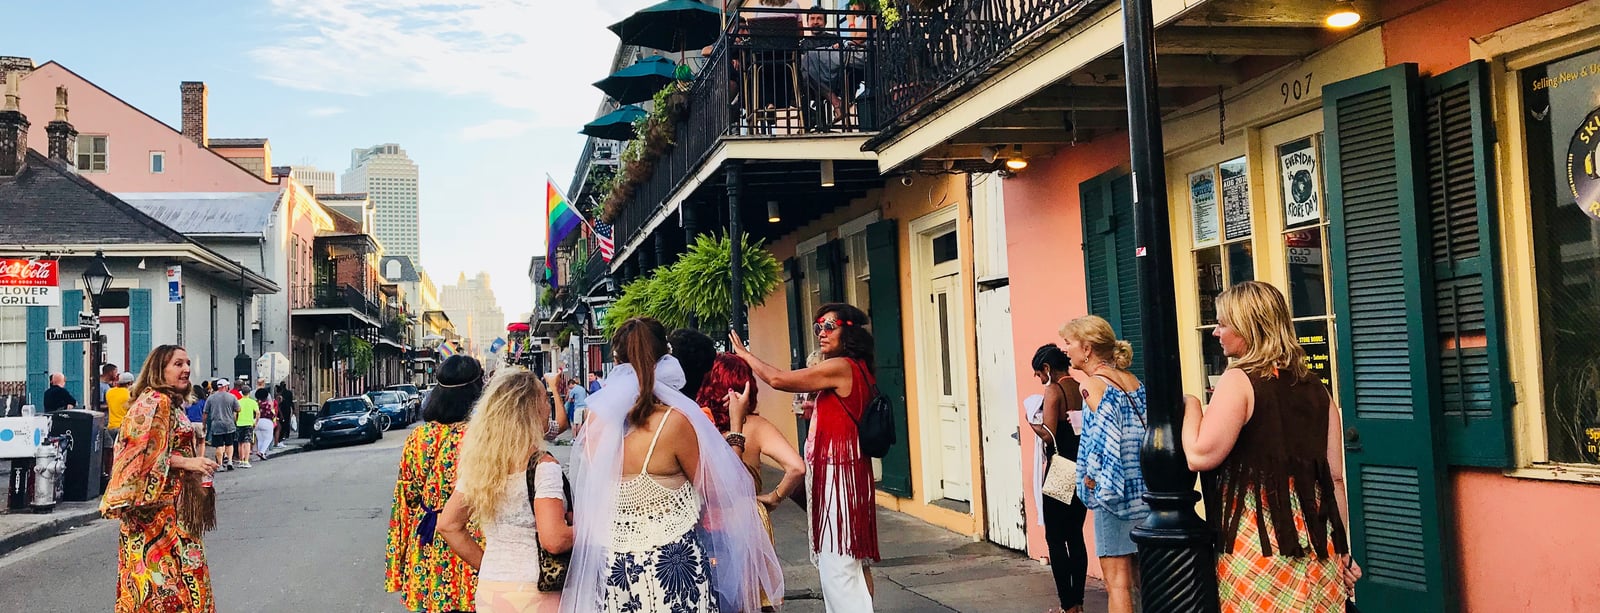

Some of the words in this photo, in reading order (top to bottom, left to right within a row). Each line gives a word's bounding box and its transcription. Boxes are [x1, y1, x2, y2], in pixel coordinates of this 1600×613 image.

[1281, 72, 1313, 105] 907
[1533, 77, 1559, 91] Selling
[1560, 71, 1579, 83] New
[1581, 65, 1588, 78] &
[1284, 152, 1316, 174] EVERYDAY
[1305, 191, 1318, 216] DAY
[1, 296, 39, 304] GRILL
[49, 331, 89, 340] Dumaine
